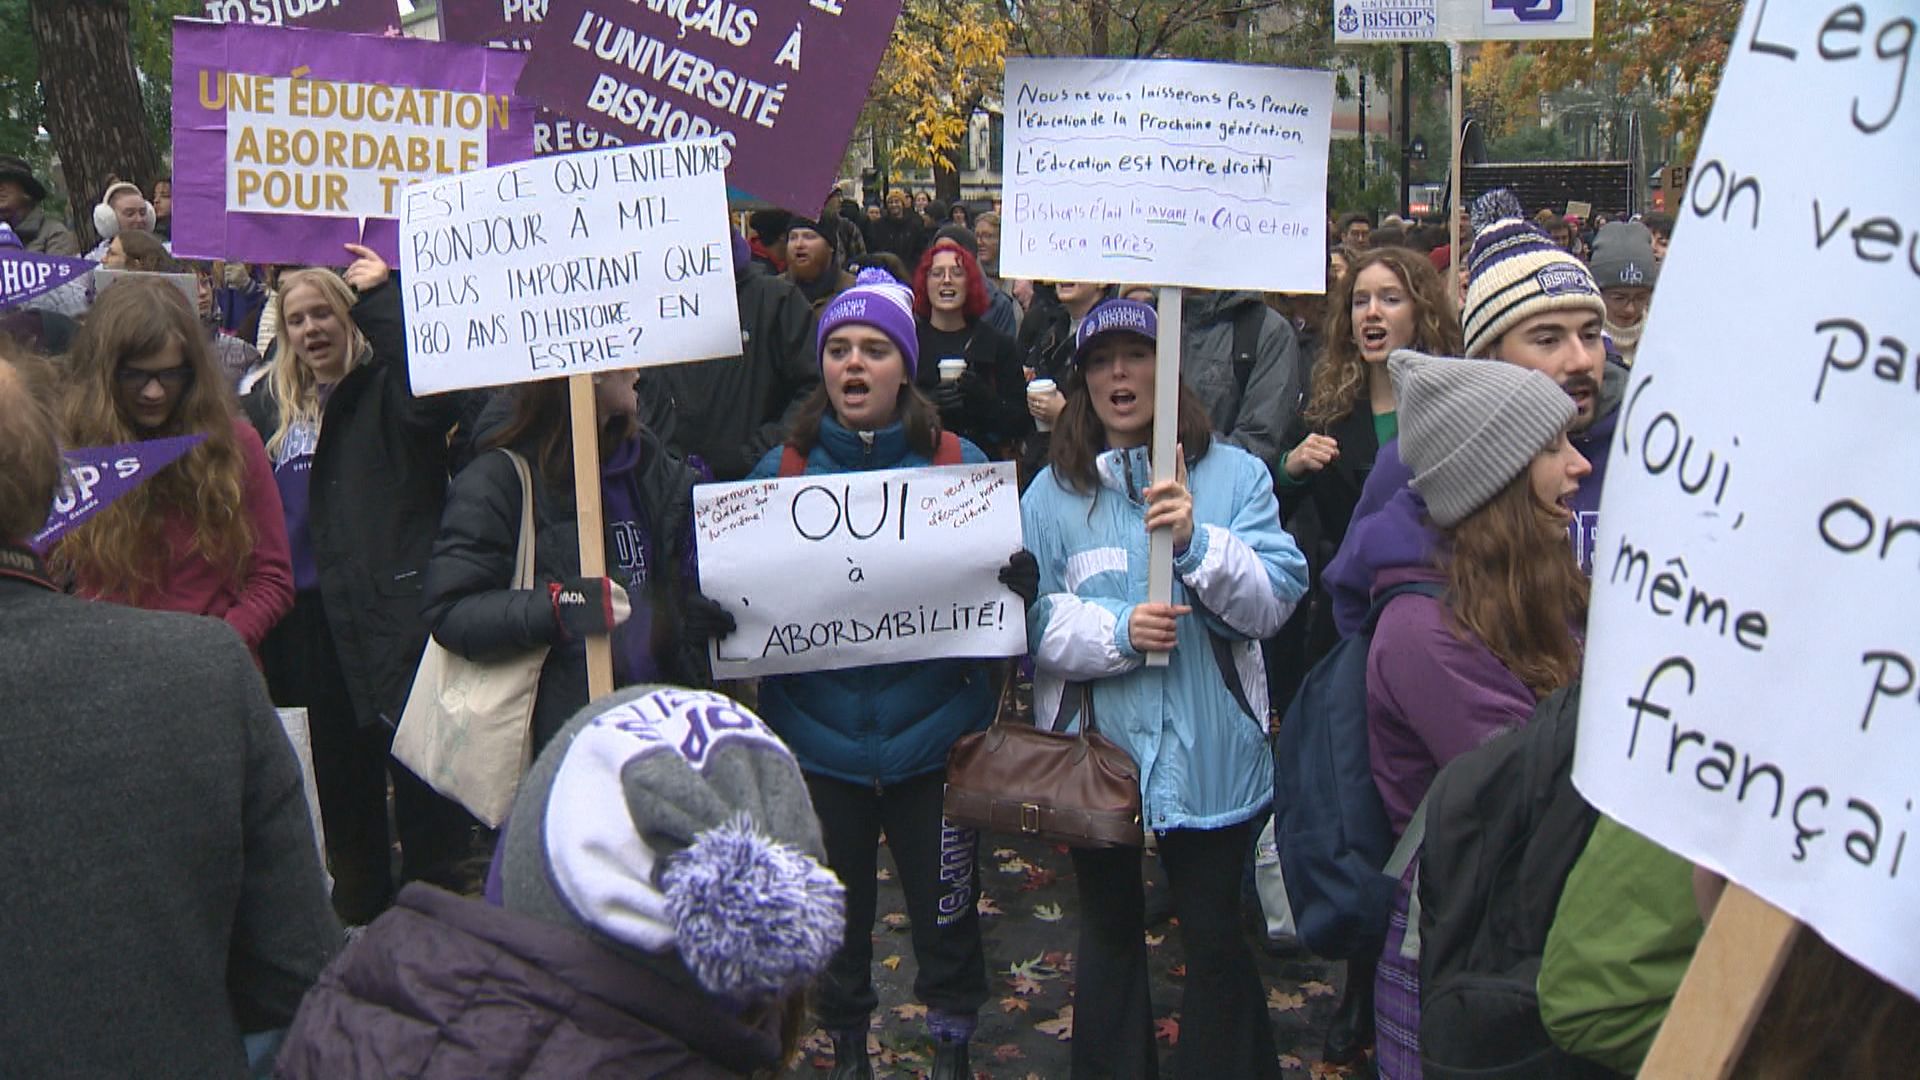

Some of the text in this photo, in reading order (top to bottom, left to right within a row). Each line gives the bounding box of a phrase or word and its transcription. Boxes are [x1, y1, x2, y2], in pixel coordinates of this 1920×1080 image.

[249, 0, 340, 26] STUD
[1363, 10, 1435, 26] BISHOP'S
[573, 10, 788, 128] L'UNIVERSITÉ
[774, 22, 802, 70] À
[200, 66, 509, 130] UNE ÉDUCATION
[1017, 83, 1068, 106] Nous
[1075, 90, 1091, 101] ne
[1141, 85, 1221, 104] laisserons
[1091, 111, 1105, 127] de
[1113, 111, 1127, 127] la
[234, 127, 479, 174] ABORDABLE
[555, 144, 727, 194] QU'ENTENDRE
[1118, 153, 1152, 172] est
[237, 170, 418, 214] POUR T
[1691, 159, 1762, 230] on
[413, 196, 680, 273] BONJOUR À MTL
[1020, 229, 1036, 256] le
[1194, 207, 1206, 225] la
[1212, 207, 1251, 234] CAQ
[1258, 217, 1276, 235] et
[1282, 222, 1309, 238] elle
[0, 259, 71, 295] HOP'S
[413, 243, 723, 312] PLUS IMPORTANT QUE
[413, 293, 700, 355] 180 ANS D'HISTOIRE EN
[1814, 317, 1920, 404] pa
[792, 481, 909, 541] OUI
[921, 497, 938, 510] On
[971, 467, 997, 488] faire
[847, 556, 865, 582] à
[1611, 534, 1769, 652] même
[1626, 655, 1912, 879] françai
